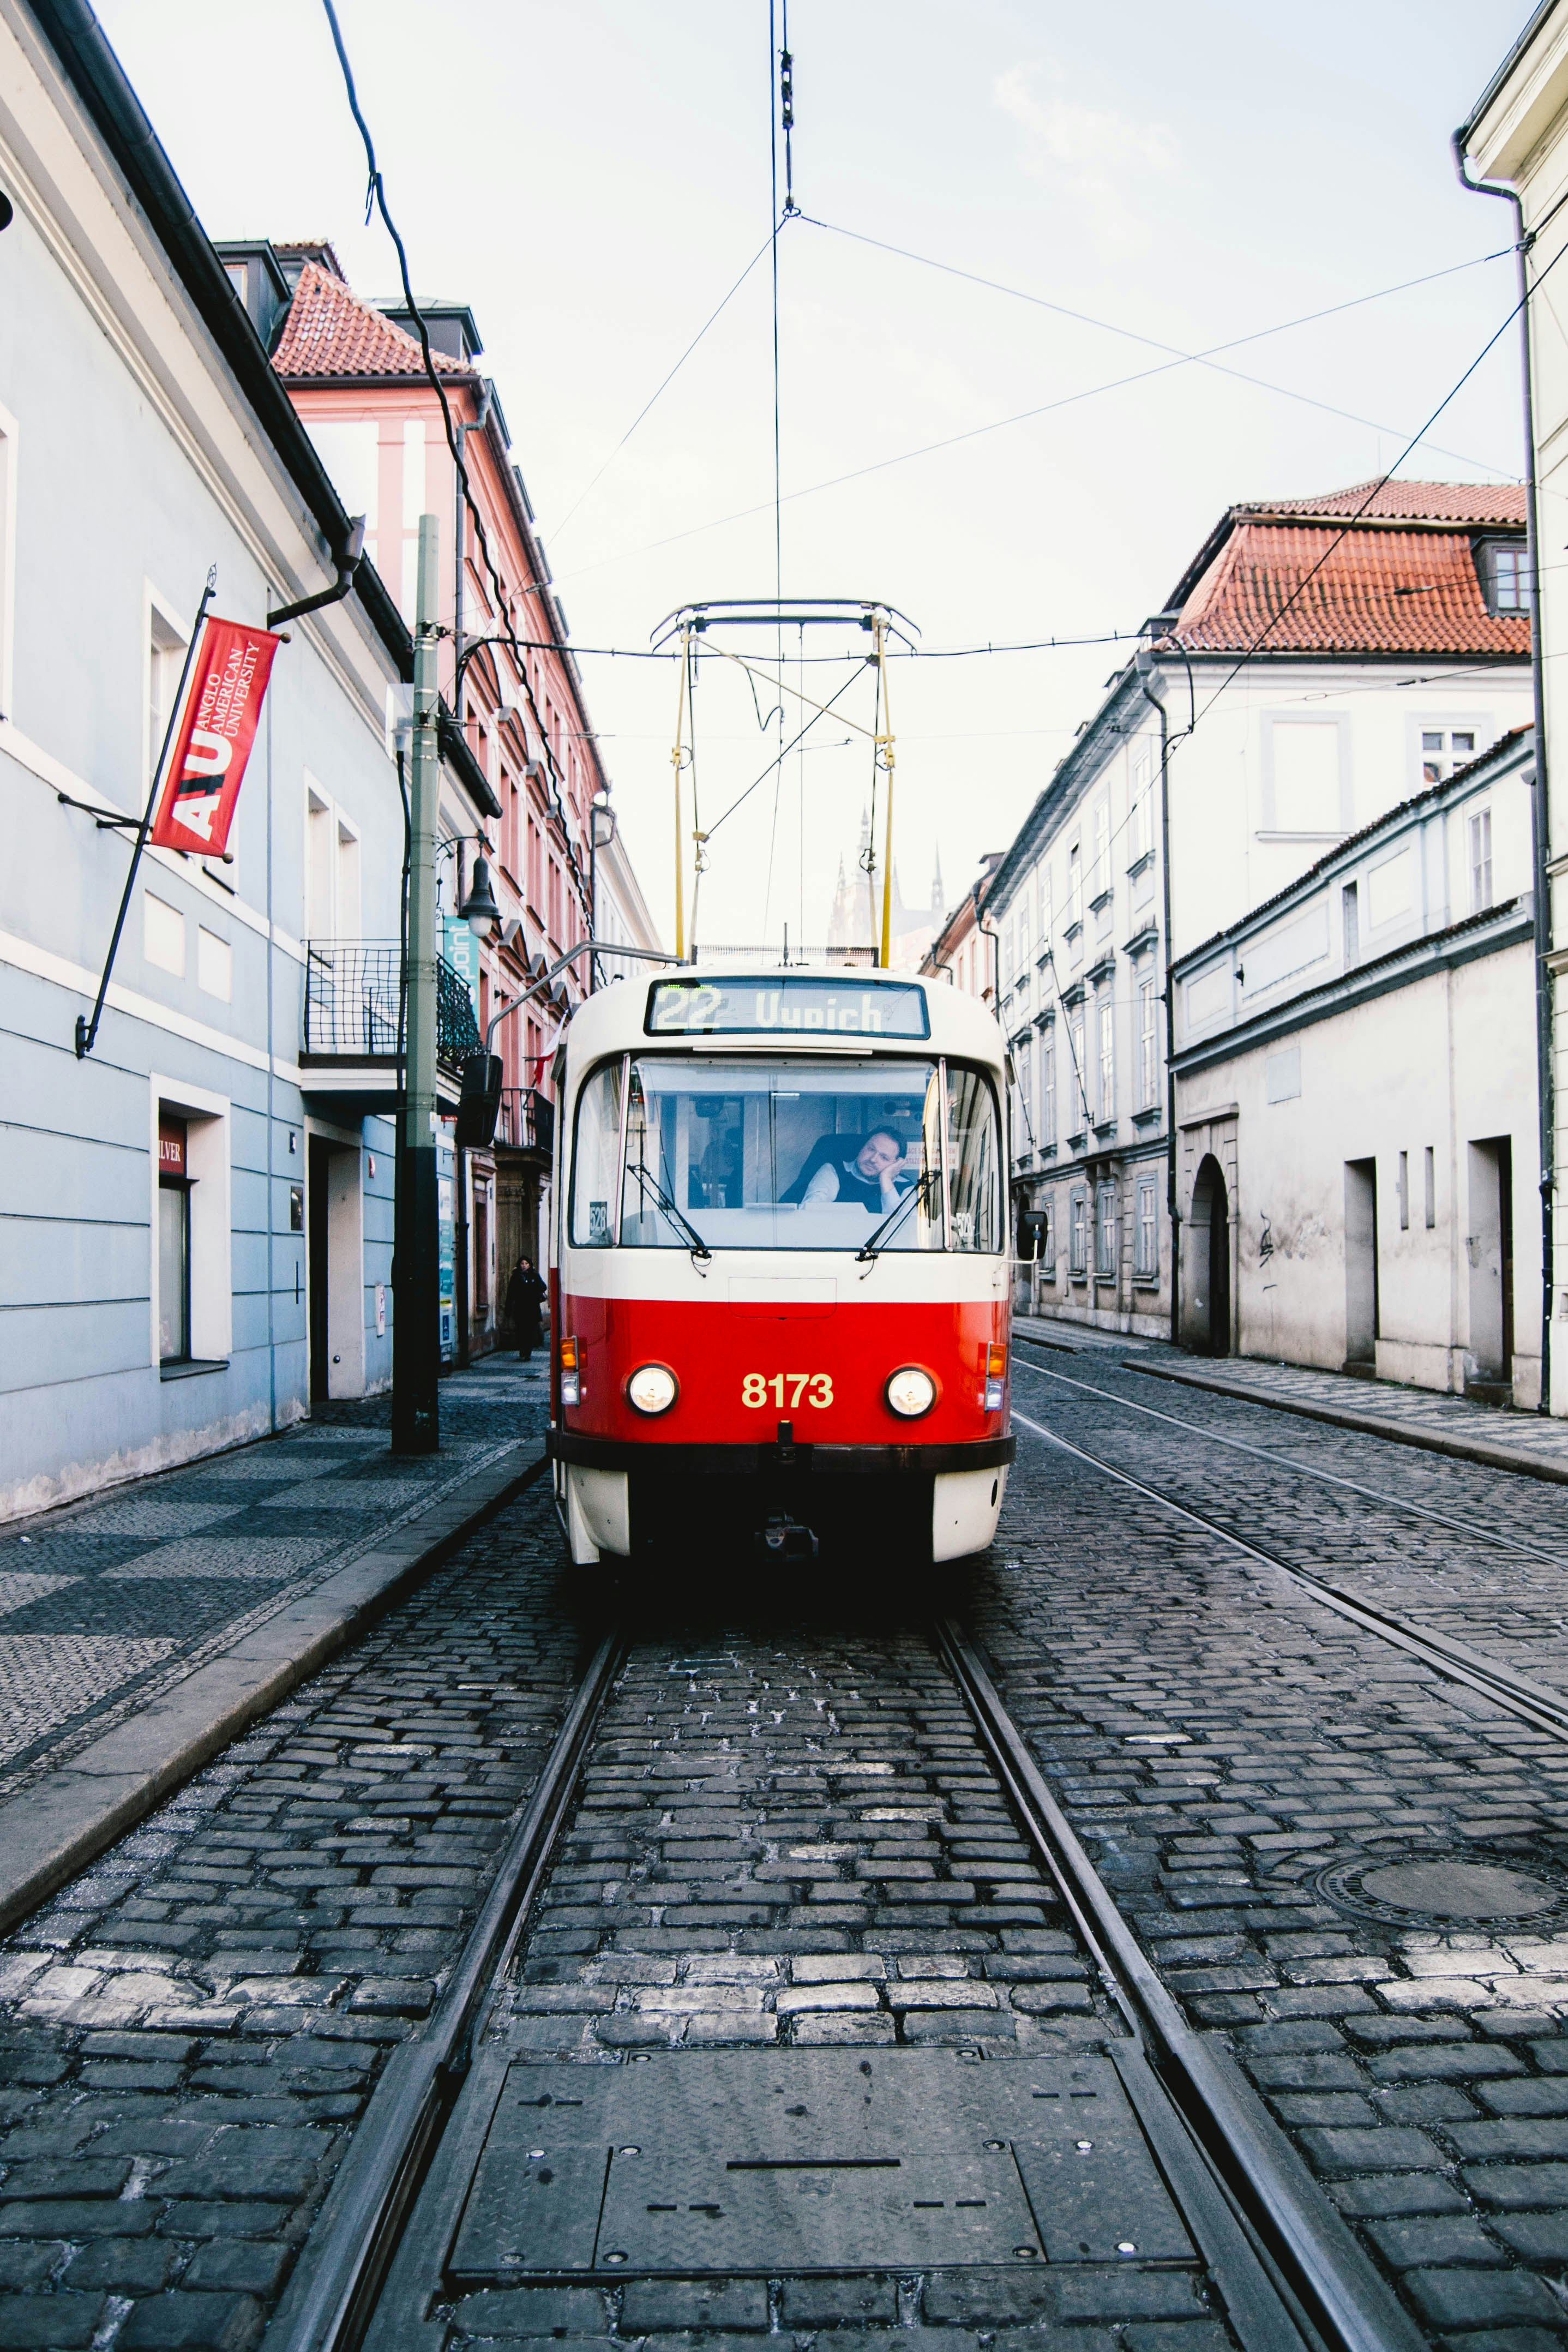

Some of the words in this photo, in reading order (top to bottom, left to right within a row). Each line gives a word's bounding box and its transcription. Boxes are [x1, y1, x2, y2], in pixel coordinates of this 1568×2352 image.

[196, 674, 221, 730] ANGLO
[211, 648, 243, 735] AMERICAN
[224, 641, 260, 737] UNIVERSITY
[657, 985, 721, 1029] 22
[590, 1207, 606, 1231] 528
[956, 1213, 972, 1238] 528
[742, 1373, 834, 1408] 8173
